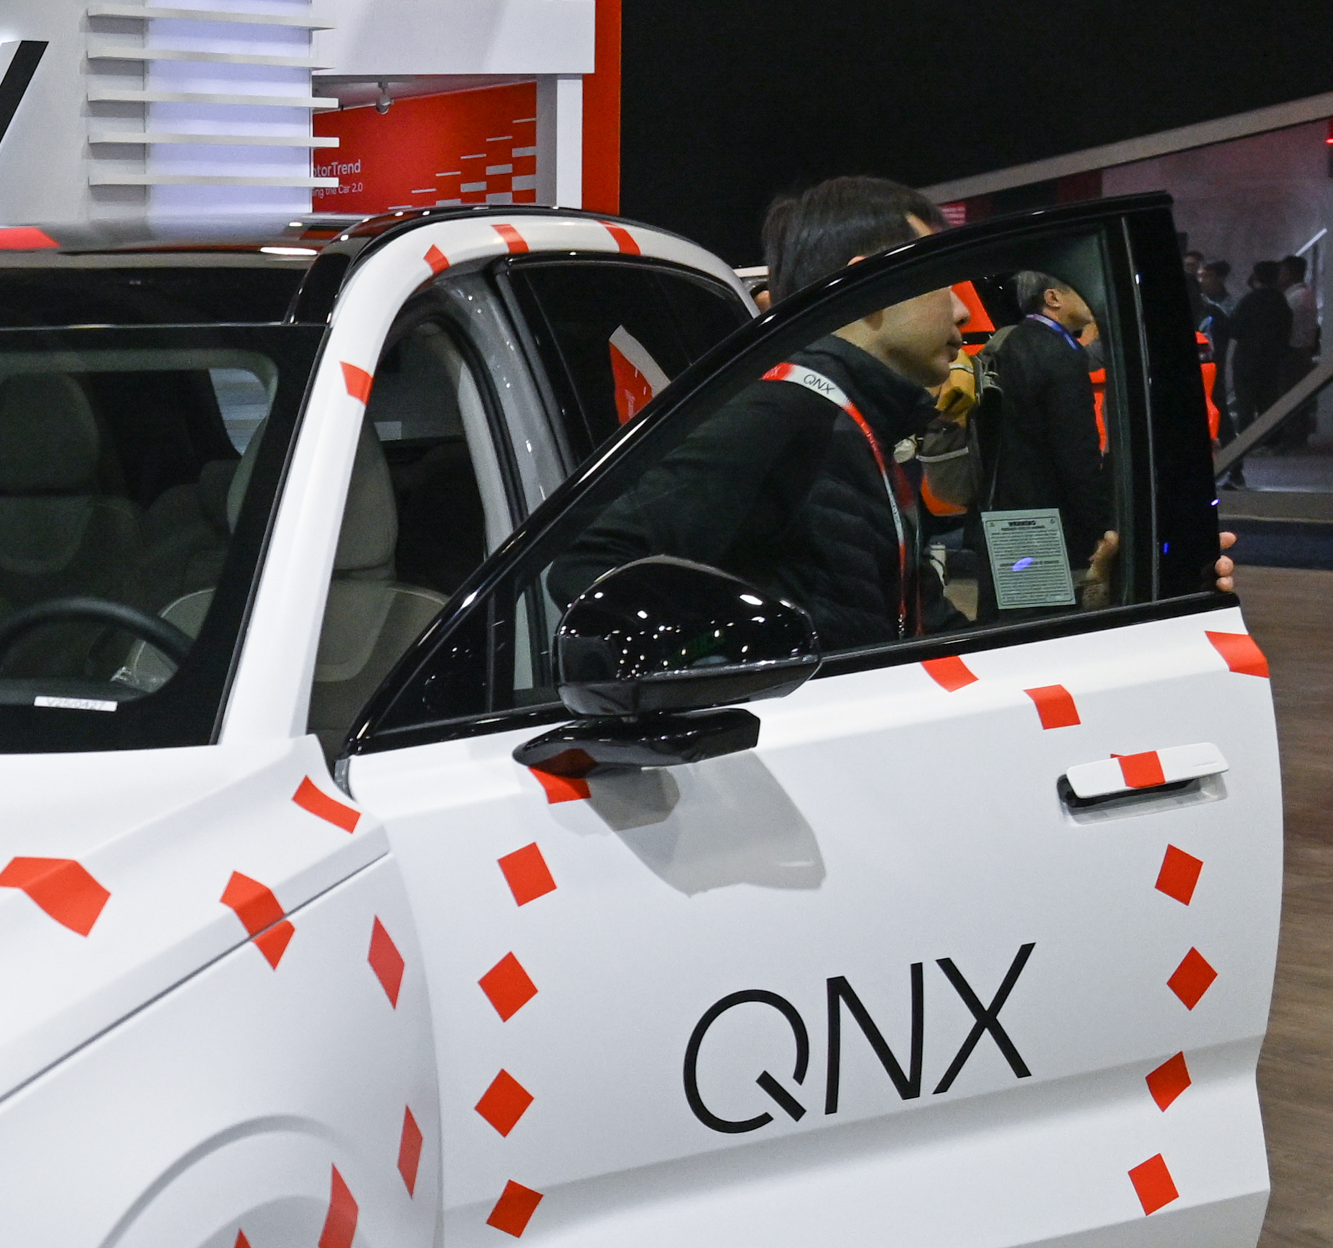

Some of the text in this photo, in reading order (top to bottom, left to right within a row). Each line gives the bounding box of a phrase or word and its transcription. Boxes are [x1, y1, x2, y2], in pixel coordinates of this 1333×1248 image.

[338, 184, 351, 194] Car
[803, 373, 836, 395] QNX
[683, 942, 1036, 1134] QNX
